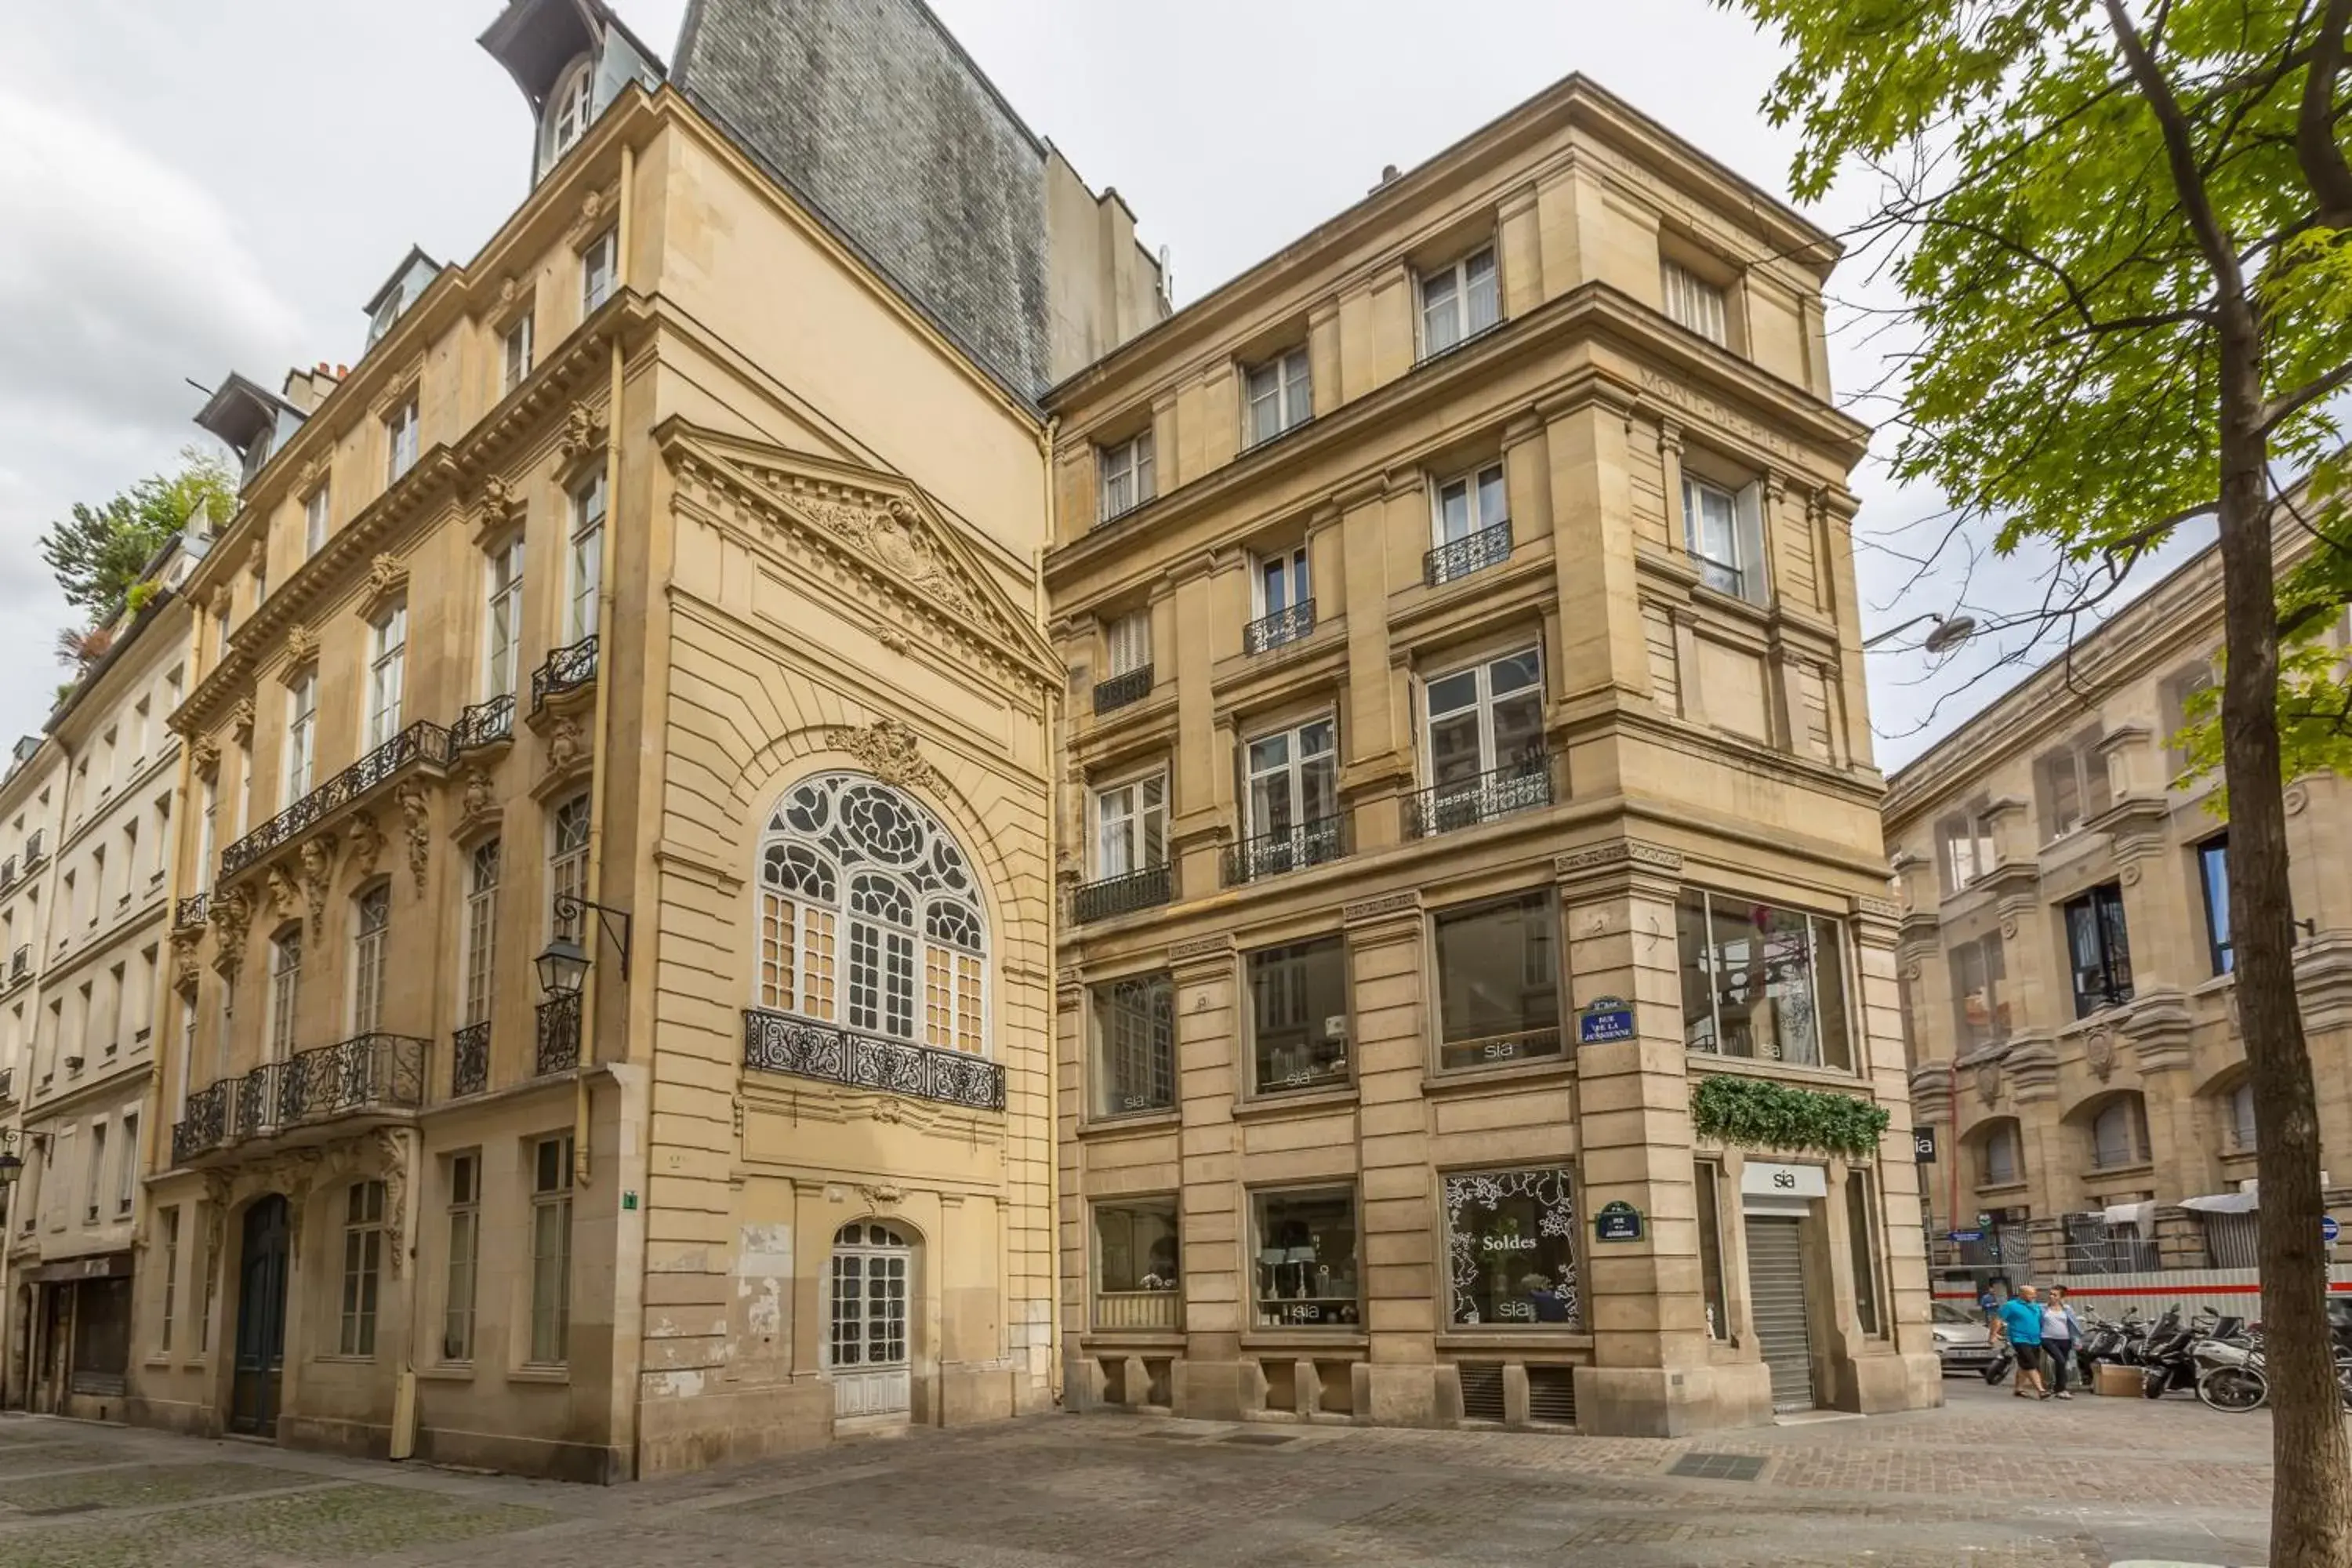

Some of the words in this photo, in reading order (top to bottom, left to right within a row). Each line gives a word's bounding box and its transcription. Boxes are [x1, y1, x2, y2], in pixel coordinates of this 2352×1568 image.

[1484, 1042, 1512, 1058] sia
[1773, 1169, 1795, 1189] sia
[1483, 1234, 1537, 1250] Soldes
[1498, 1301, 1529, 1317] sia
